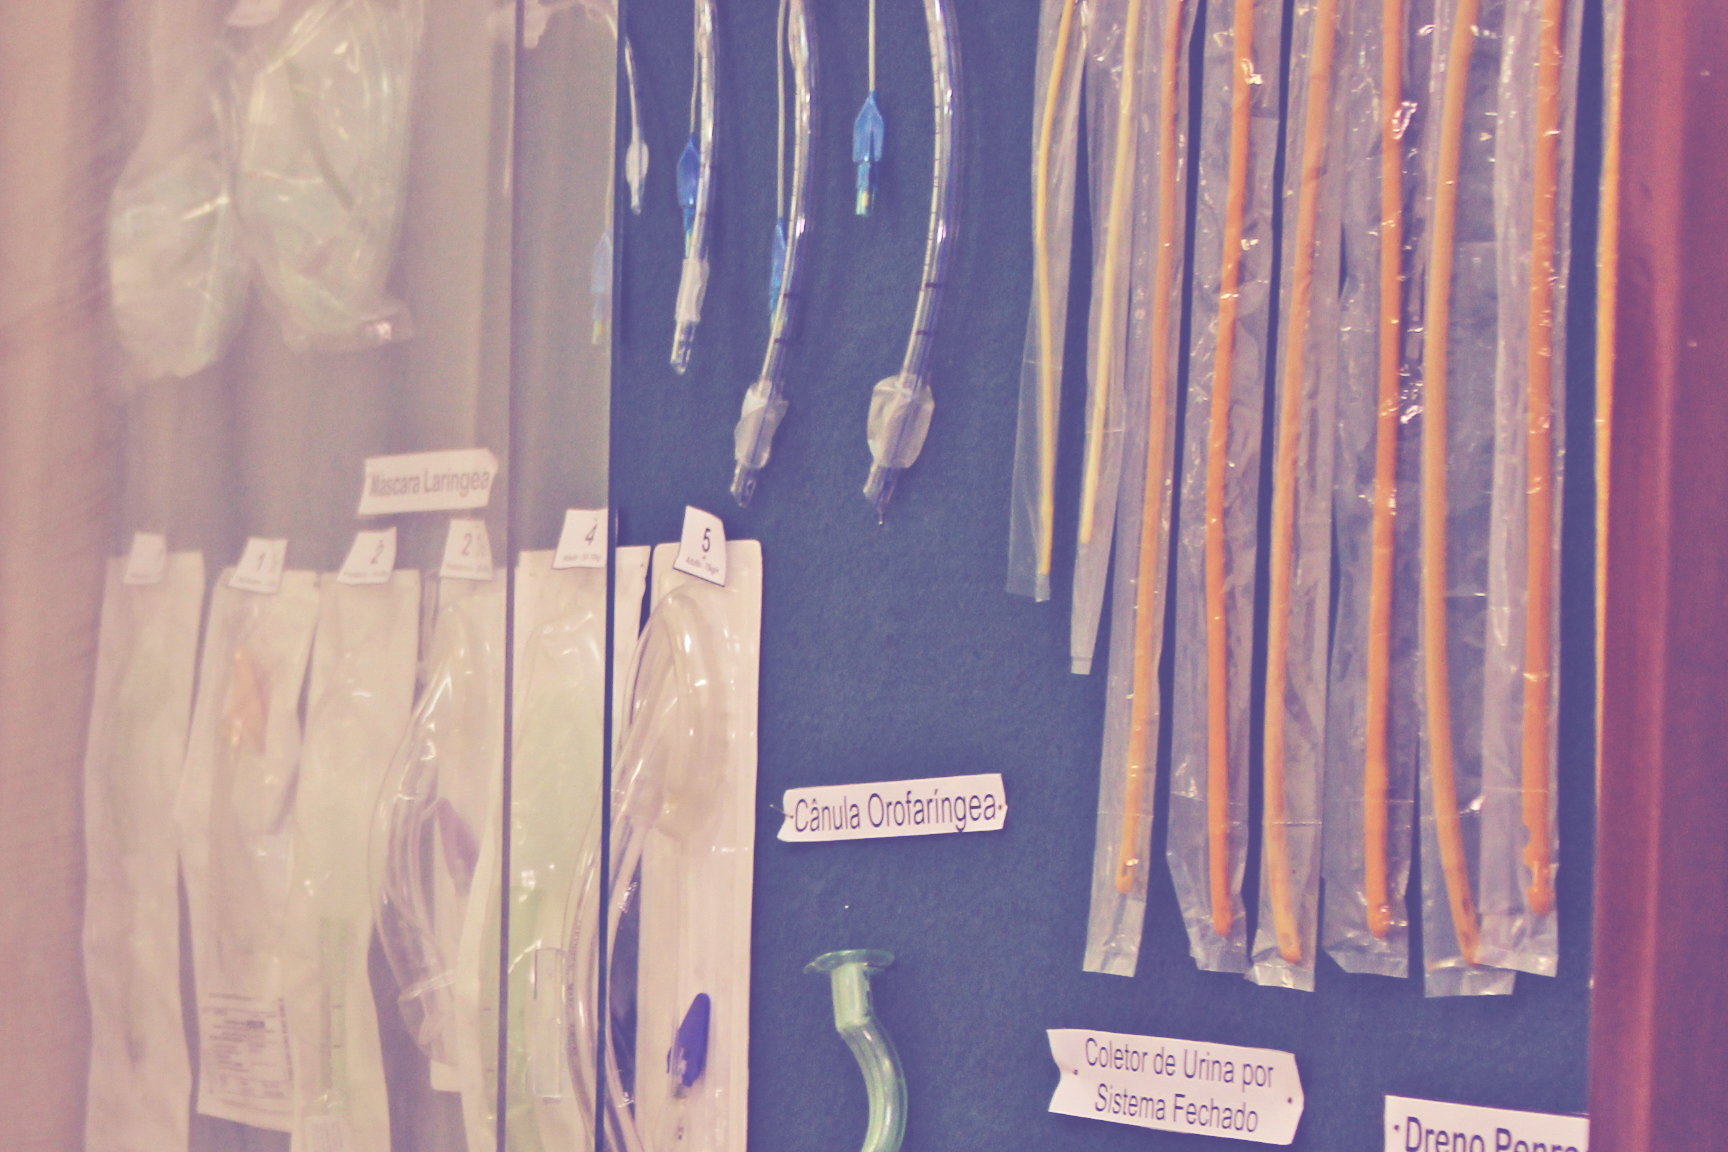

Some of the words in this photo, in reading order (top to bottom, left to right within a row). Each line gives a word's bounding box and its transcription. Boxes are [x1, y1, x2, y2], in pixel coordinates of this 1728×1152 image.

[701, 527, 712, 553] 5
[794, 796, 861, 833] Cânula
[867, 788, 997, 833] Orofaríngea
[1084, 1037, 1148, 1073] Coletor
[1152, 1046, 1177, 1077] de
[1183, 1049, 1235, 1083] Urina
[1240, 1062, 1274, 1093] por
[1094, 1083, 1166, 1121] Sistema
[1172, 1093, 1260, 1133] Fechado
